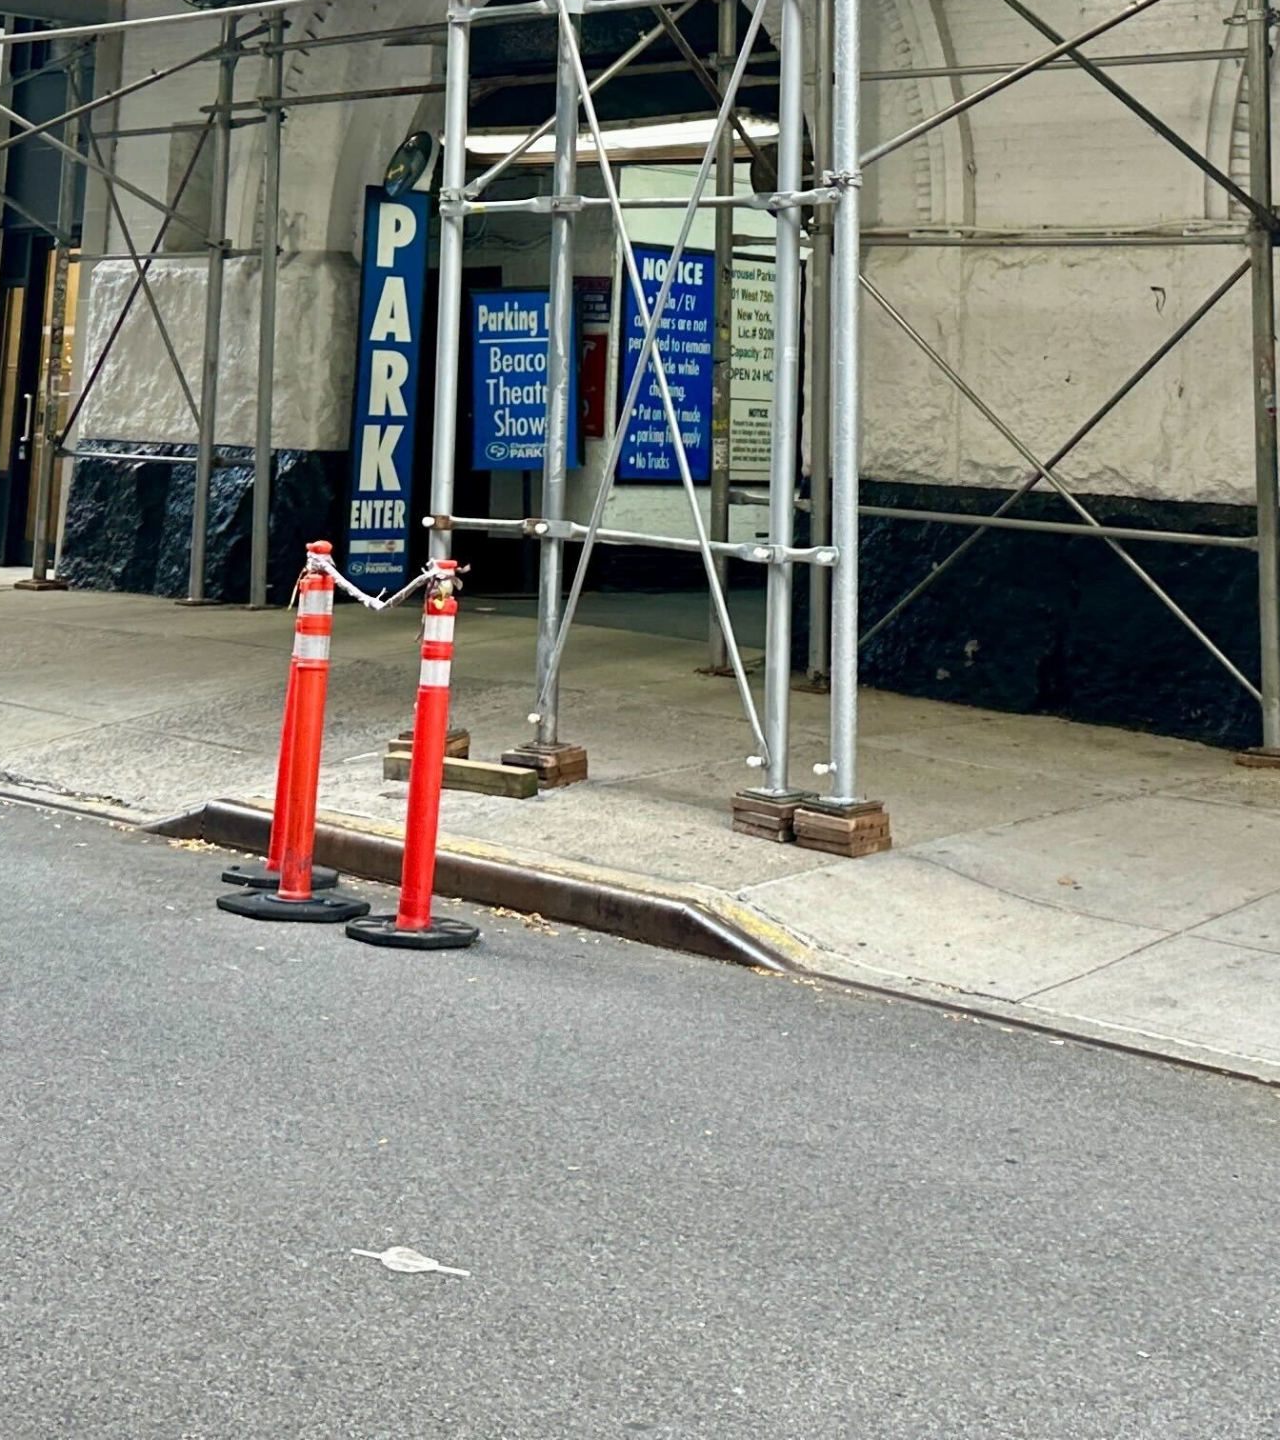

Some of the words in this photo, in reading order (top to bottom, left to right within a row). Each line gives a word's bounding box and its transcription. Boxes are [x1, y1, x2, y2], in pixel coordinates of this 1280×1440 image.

[642, 257, 704, 286] NOICE
[731, 268, 755, 281] rousel
[756, 268, 776, 282] Park
[685, 294, 696, 311] EV
[731, 288, 739, 300] 01
[478, 302, 538, 336] Parking
[737, 308, 753, 321] New
[677, 319, 692, 331] are
[693, 318, 708, 332] not
[358, 202, 417, 491] PARK
[628, 334, 670, 354] perted
[671, 337, 680, 352] to
[681, 339, 711, 355] remain
[490, 347, 549, 373] Beaco
[678, 358, 700, 376] while
[486, 376, 549, 405] Theatr
[494, 407, 547, 437] Show
[638, 404, 651, 420] Put
[681, 405, 700, 422] mode
[637, 425, 664, 447] parking
[510, 448, 544, 458] PARK
[635, 452, 646, 469] No
[647, 451, 670, 470] Trucks
[350, 499, 406, 529] ENTER
